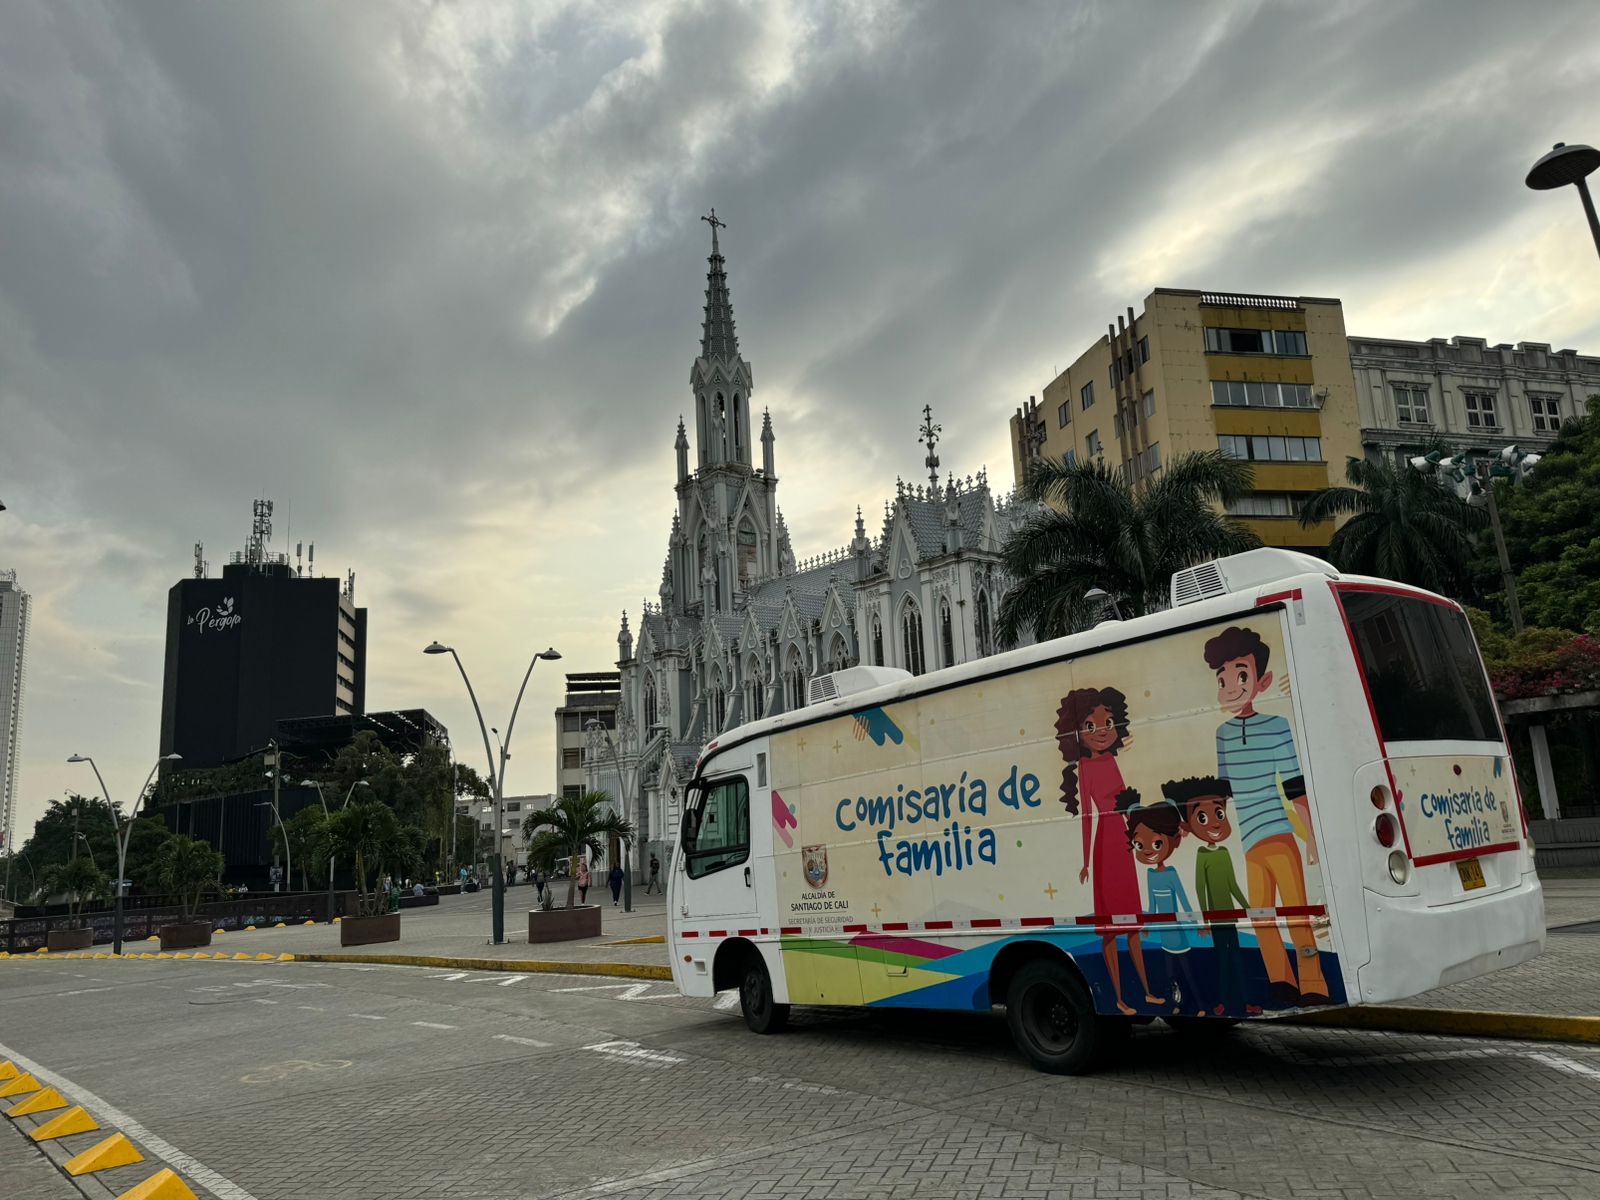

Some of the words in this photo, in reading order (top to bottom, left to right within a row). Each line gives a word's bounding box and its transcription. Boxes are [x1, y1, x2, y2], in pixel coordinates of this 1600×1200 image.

[998, 765, 1041, 810] de
[1484, 785, 1497, 811] de
[801, 890, 827, 900] ALCALDÍA
[791, 902, 822, 911] SANTIAGO
[824, 901, 833, 909] DE
[834, 900, 849, 909] CALI
[788, 916, 816, 925] SECRETARÍA
[825, 915, 853, 924] SEGURIDAD
